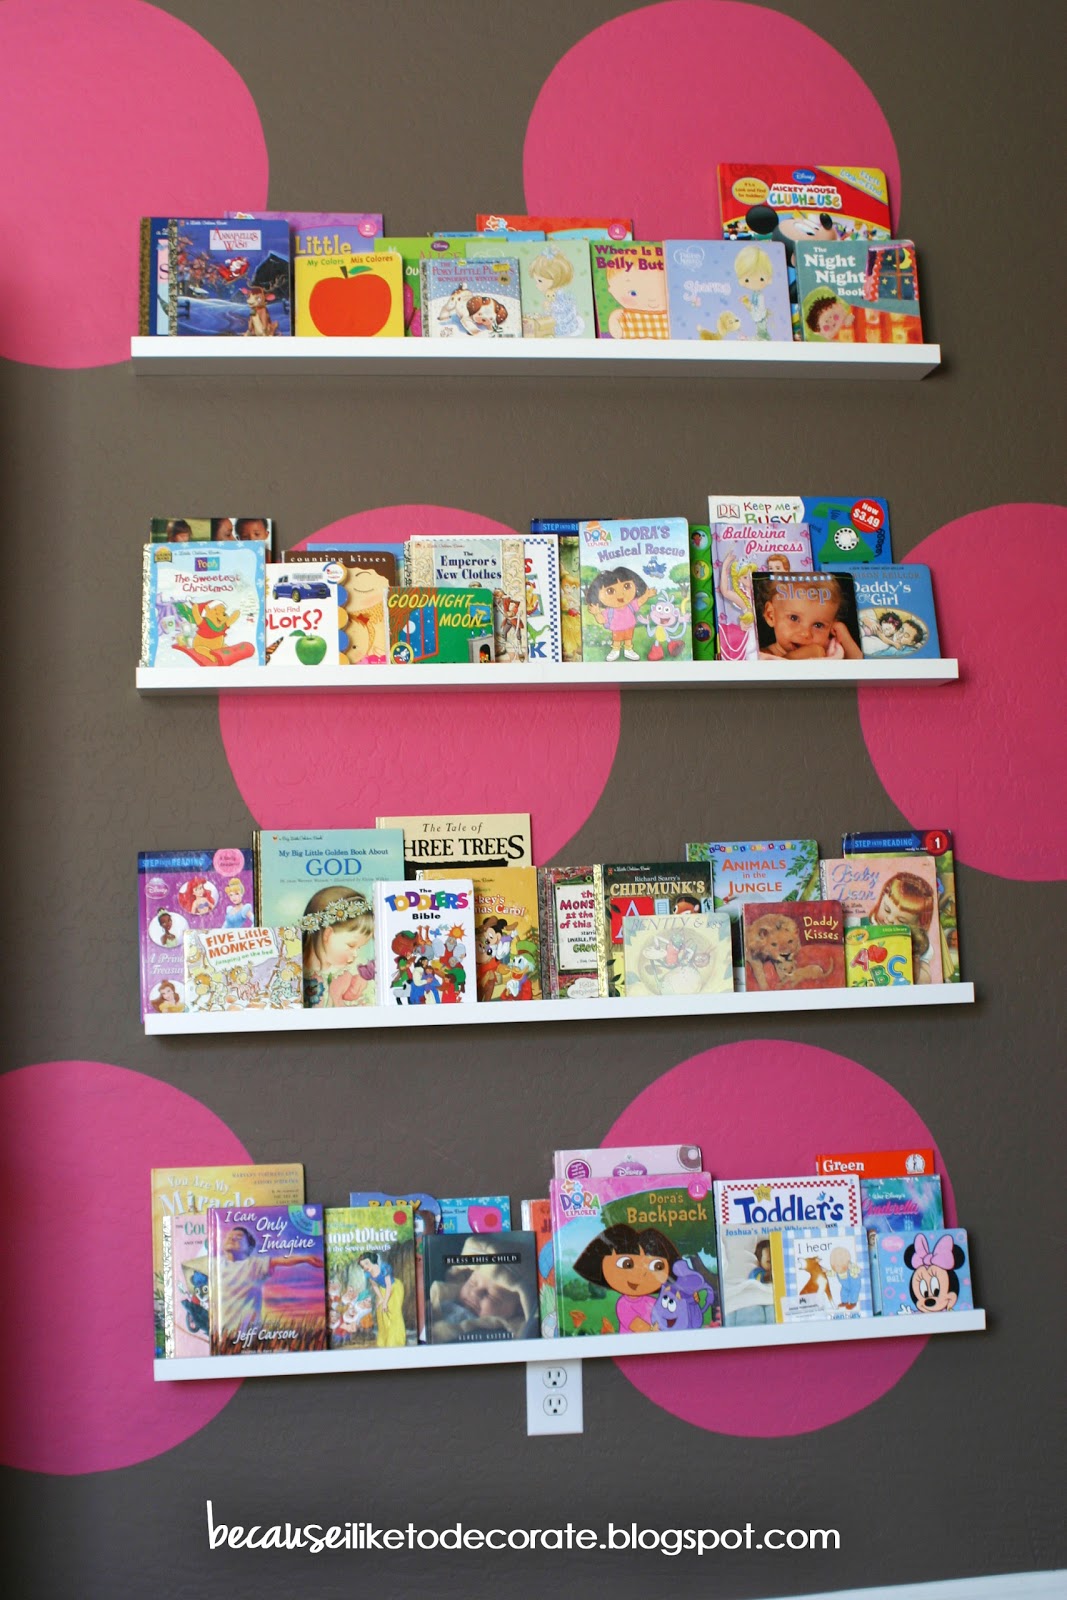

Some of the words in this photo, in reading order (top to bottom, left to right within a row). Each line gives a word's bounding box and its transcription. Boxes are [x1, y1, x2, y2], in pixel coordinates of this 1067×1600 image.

[795, 171, 815, 180] Disney
[295, 234, 352, 255] Little
[594, 244, 637, 255] Where
[641, 246, 651, 255] Is
[366, 255, 393, 263] Colores
[596, 256, 633, 272] Belly
[638, 257, 664, 271] But
[804, 254, 856, 270] Night
[815, 270, 867, 286] Night
[837, 287, 866, 296] Book
[717, 503, 740, 517] DK
[743, 501, 772, 513] Keep
[852, 508, 881, 528] $3.49
[542, 523, 560, 531] STEP
[619, 526, 671, 541] DORA'S
[722, 525, 786, 541] Ballerina
[583, 529, 612, 543] DORA
[597, 542, 642, 563] Musical
[644, 543, 686, 558] Rescue
[745, 540, 804, 555] Princess
[290, 554, 343, 563] counting
[350, 554, 387, 562] kisses
[440, 554, 497, 569] Emperor's
[174, 574, 190, 583] The
[192, 573, 241, 583] Sweetest
[436, 568, 458, 580] New
[461, 568, 502, 580] Clothes
[182, 583, 234, 593] Christmas
[775, 584, 832, 604] Sleep
[388, 593, 475, 609] GOODNIGHT
[870, 593, 899, 606] Girl
[287, 605, 301, 613] Find
[439, 612, 484, 628] MOON
[422, 823, 441, 833] The
[446, 822, 467, 832] Tale
[471, 822, 483, 834] of
[458, 834, 526, 860] TREES
[855, 840, 871, 848] STEP
[883, 838, 913, 847] READING
[934, 837, 940, 849] 1
[279, 850, 290, 858] My
[291, 849, 303, 858] Big
[304, 849, 323, 857] Little
[325, 848, 349, 856] Golden
[350, 847, 367, 856] Book
[368, 848, 389, 856] About
[143, 858, 159, 867] STEP
[305, 857, 362, 877] GOD
[722, 858, 787, 872] ANIMALS
[634, 875, 656, 883] Richard
[658, 874, 681, 882] Scarry's
[743, 871, 751, 879] in
[753, 871, 767, 879] the
[831, 863, 880, 889] Baby
[147, 886, 168, 894] Disney
[609, 880, 706, 897] CHIPMUNK'S
[728, 880, 782, 896] JUNGLE
[412, 912, 441, 920] Bible
[495, 903, 526, 917] Carol
[566, 911, 577, 919] at
[579, 910, 593, 919] the
[559, 921, 572, 930] of
[573, 919, 592, 928] this
[803, 916, 839, 931] Daddy
[206, 931, 235, 947] FIVE
[238, 928, 269, 941] Little
[804, 929, 839, 941] Kisses
[209, 936, 273, 958] MONKEYS
[822, 1158, 865, 1172] Green
[167, 1175, 189, 1188] You
[193, 1175, 211, 1189] Are
[215, 1179, 230, 1196] My
[159, 1189, 256, 1216] Miracle
[560, 1191, 600, 1211] DORA
[650, 1192, 684, 1204] Dora's
[872, 1192, 886, 1200] Walt
[626, 1203, 708, 1227] Backpack
[733, 1193, 845, 1224] Toddler's
[225, 1211, 232, 1223] I
[233, 1211, 257, 1222] Can
[256, 1216, 288, 1237] Only
[725, 1228, 759, 1237] Joshua's
[355, 1226, 398, 1244] White
[258, 1233, 315, 1258] Imagine
[333, 1245, 344, 1253] the
[345, 1245, 365, 1253] Seven
[366, 1243, 392, 1253] Dwarfs
[806, 1241, 833, 1252] hear
[492, 1255, 518, 1263] CHILD
[232, 1326, 258, 1348] Jeff
[258, 1328, 299, 1341] Carson
